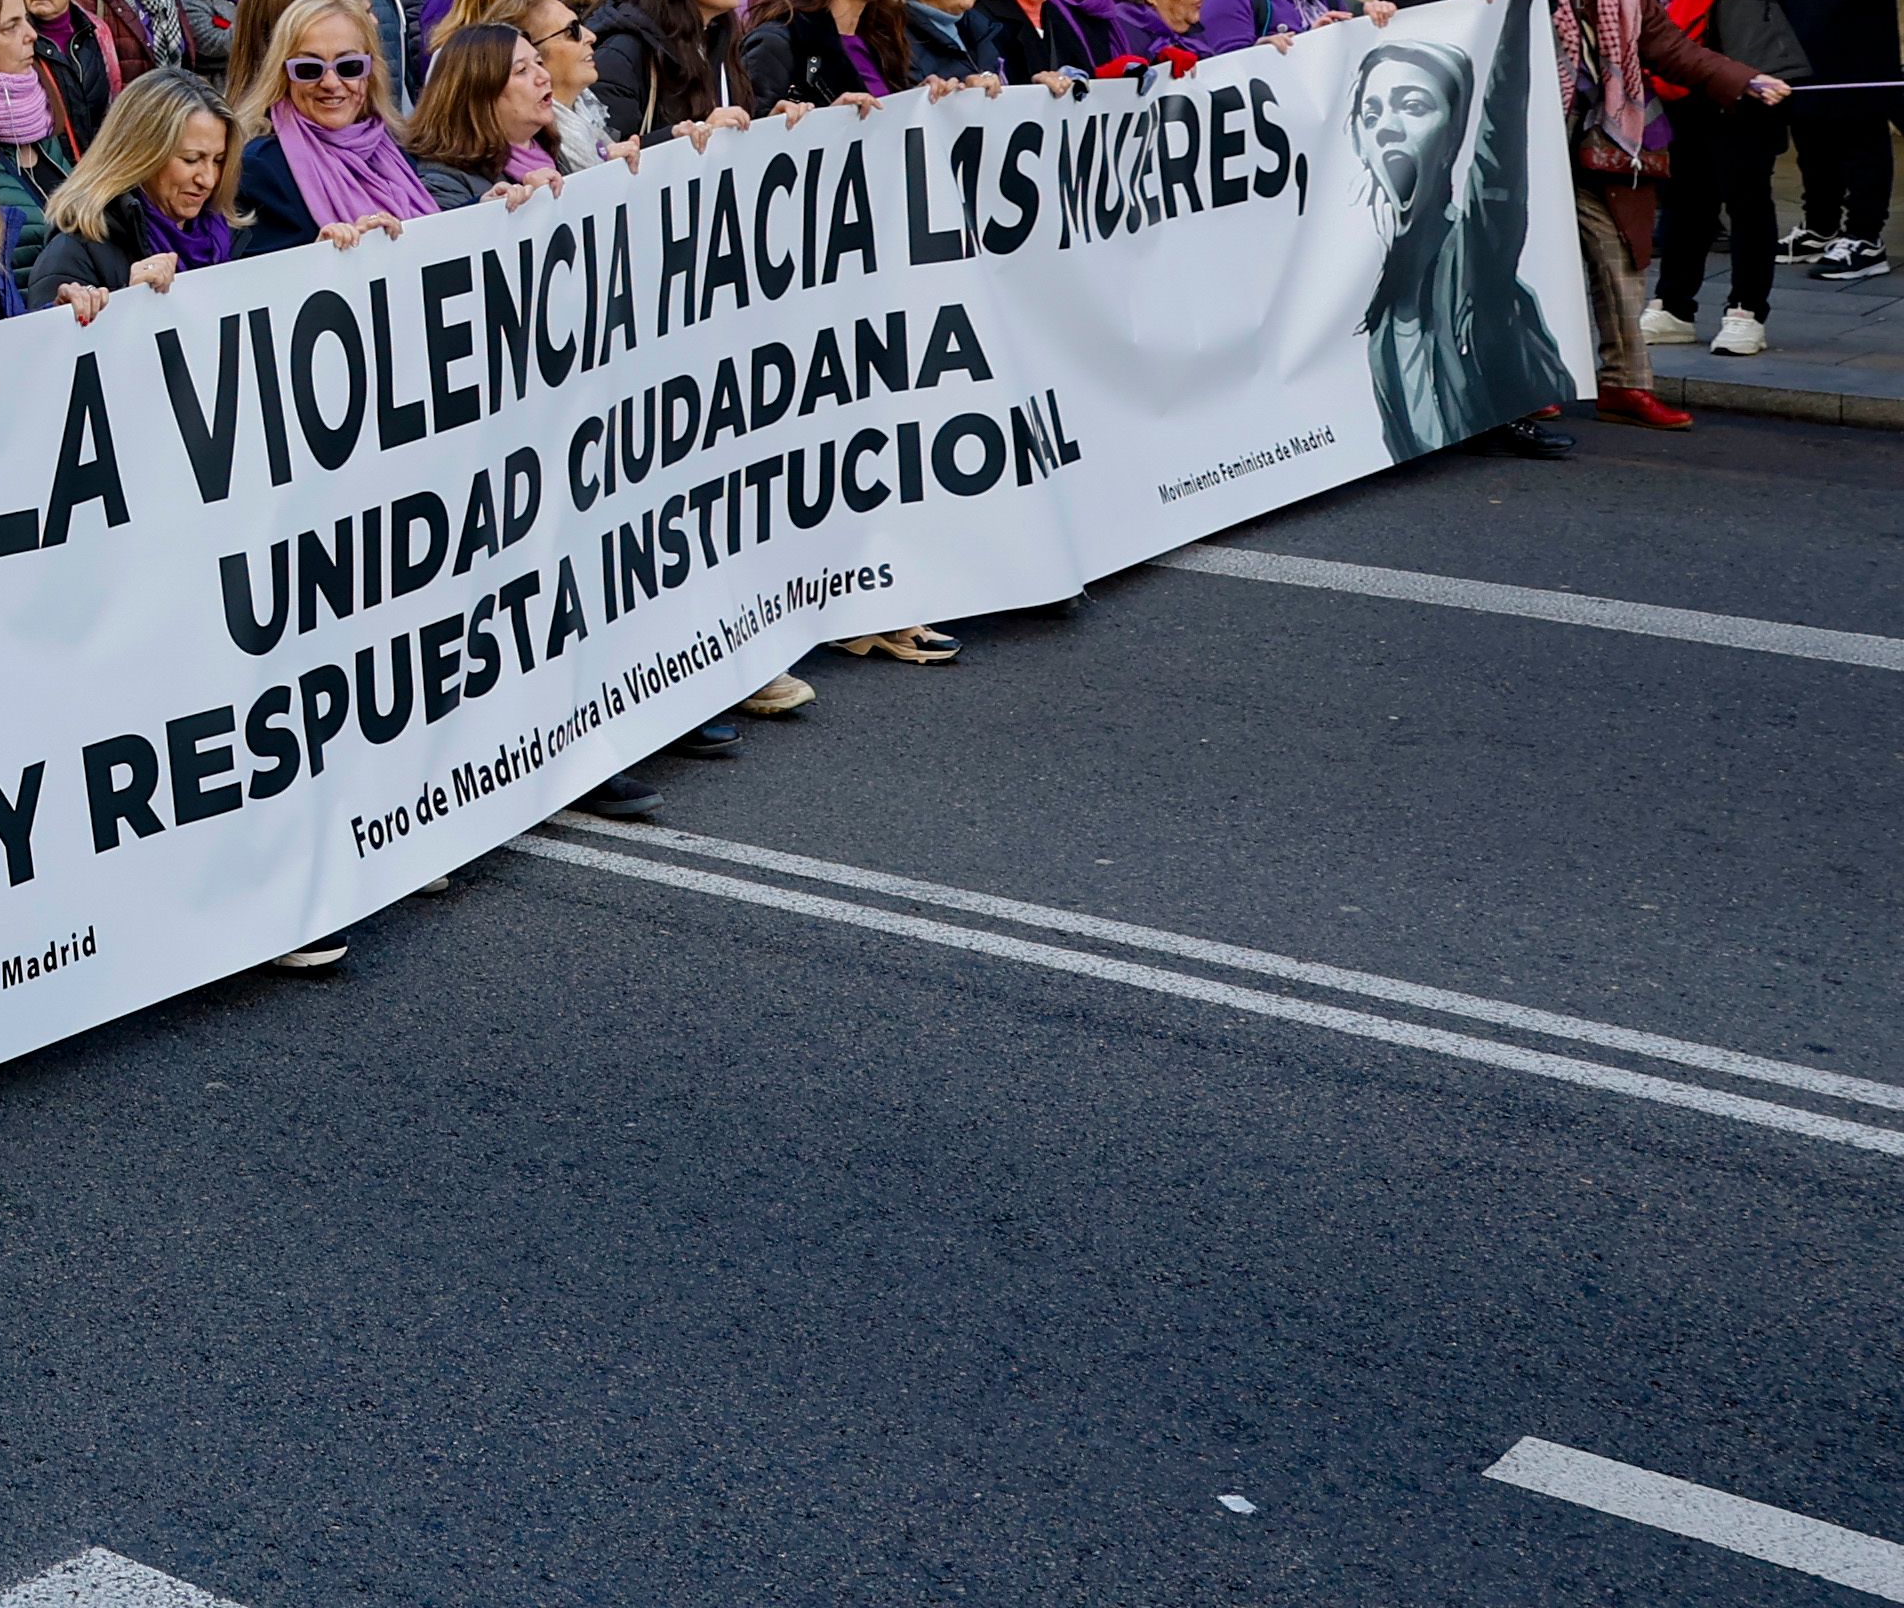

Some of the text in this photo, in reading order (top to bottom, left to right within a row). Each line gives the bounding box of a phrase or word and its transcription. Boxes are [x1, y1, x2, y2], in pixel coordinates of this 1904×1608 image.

[154, 203, 637, 504] VIOLENCIA
[657, 139, 878, 338] HACIA
[1058, 78, 1309, 250] MUJERES,
[218, 303, 994, 656] UNIDAD CIUDADANA
[1158, 425, 1336, 505] Movimiento Feminista de Madrid
[81, 554, 589, 855] RESPUESTA
[350, 563, 894, 859] Foro de Madrid contra la Violencia hacia las Mujeres
[2, 925, 98, 991] Madrid
